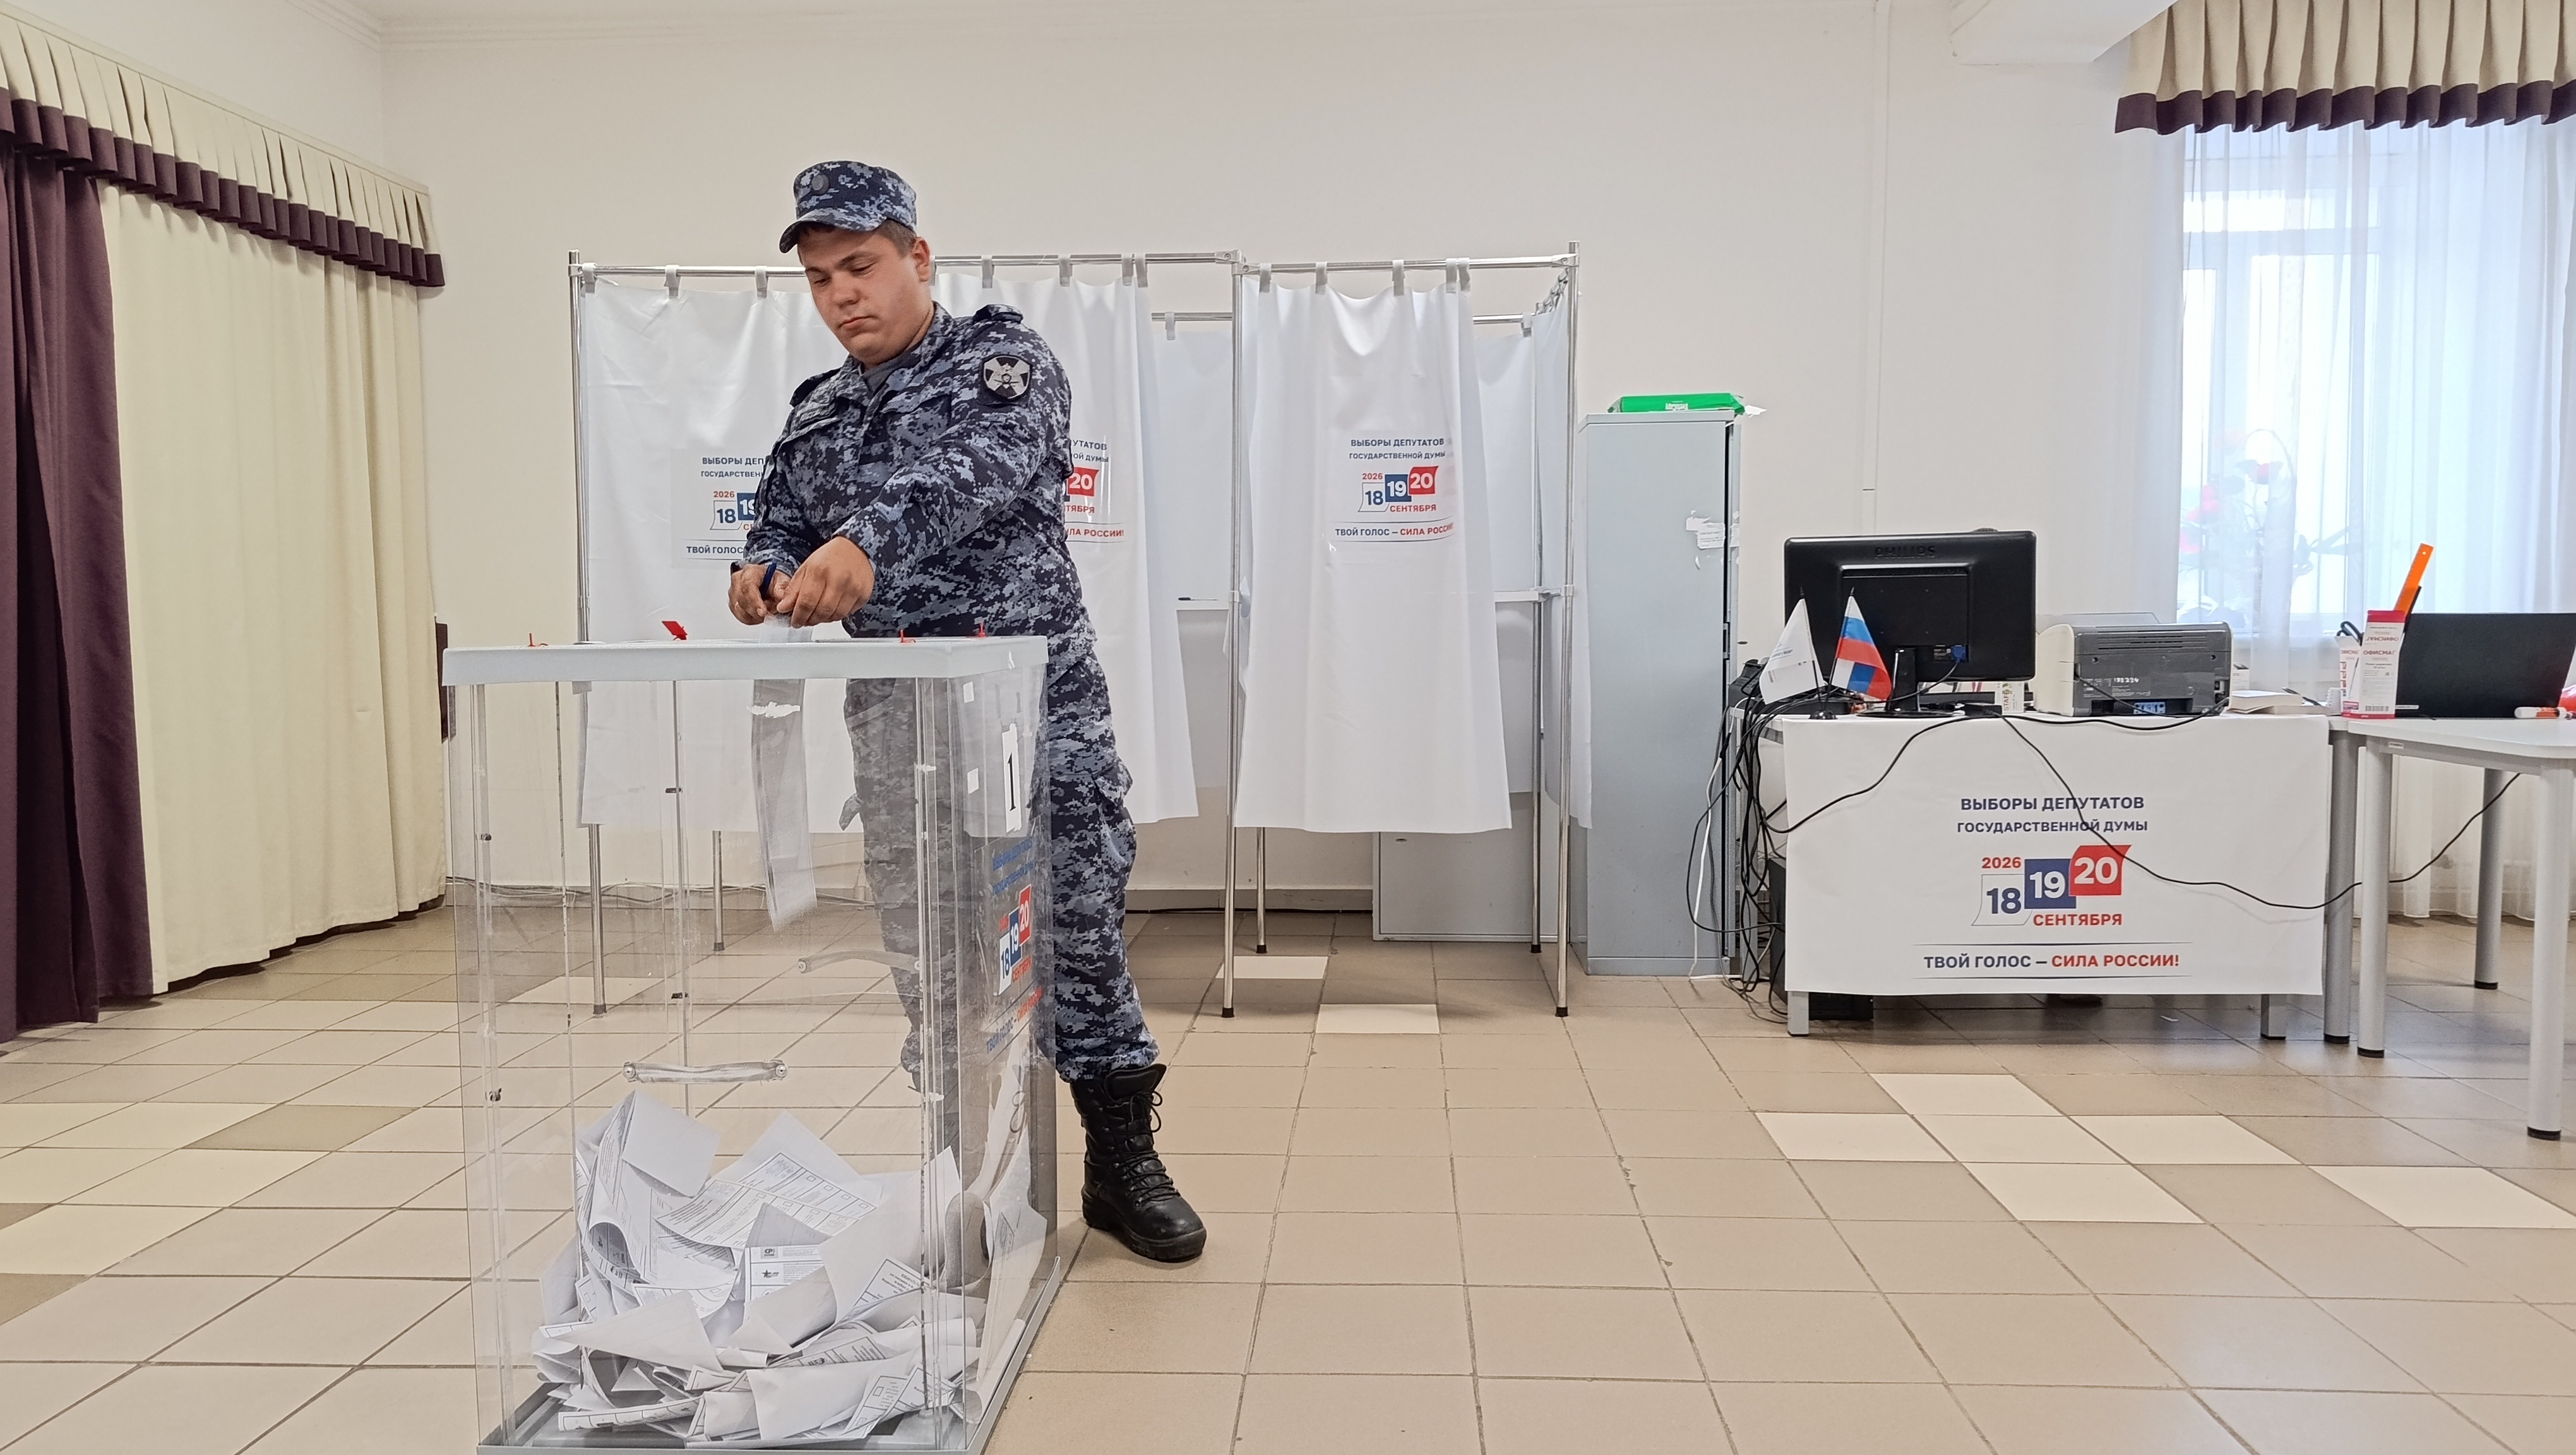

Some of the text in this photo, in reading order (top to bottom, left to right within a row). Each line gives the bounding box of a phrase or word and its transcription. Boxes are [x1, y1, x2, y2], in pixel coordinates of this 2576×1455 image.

[1073, 440, 1107, 450] УТАТОВ
[1351, 437, 1445, 448] ВЫБОРЫ ДЕПУТАТОВ
[1085, 455, 1109, 463] ДУМЫ
[1349, 450, 1446, 460] ГОСУДАРСТВЕННОЙ ДУМЫ
[1069, 472, 1093, 490] 20
[1365, 472, 1434, 506] 18 19 20
[1064, 505, 1095, 514] ТЯБРЯ
[1390, 504, 1437, 513] СЕНТЯБРЯ
[717, 508, 736, 524] 18
[1084, 529, 1124, 537] РОССИИ!
[1335, 527, 1358, 536] ТВОЙ
[1400, 528, 1425, 536] СИЛА
[686, 544, 711, 554] ТВОЙ
[1874, 545, 1936, 560] PHILIPS
[1005, 751, 1017, 811] 1
[1960, 796, 2145, 813] ВЫБОРЫ ДЕПУТАТОВ
[1957, 819, 2149, 834] ГОСУДАРСТВЕННОЙ ДУМЫ
[1981, 856, 2022, 869] 2026
[1986, 856, 2119, 916] 18 19 20
[2032, 913, 2123, 926] СЕНТЯБРЯ
[1001, 899, 1030, 979] 18 19 20
[1924, 953, 1970, 969] ТВОЙ
[1974, 955, 2032, 968] ГОЛОС
[2051, 955, 2099, 967] СИЛА
[2103, 954, 2180, 967] РОССИИ!
